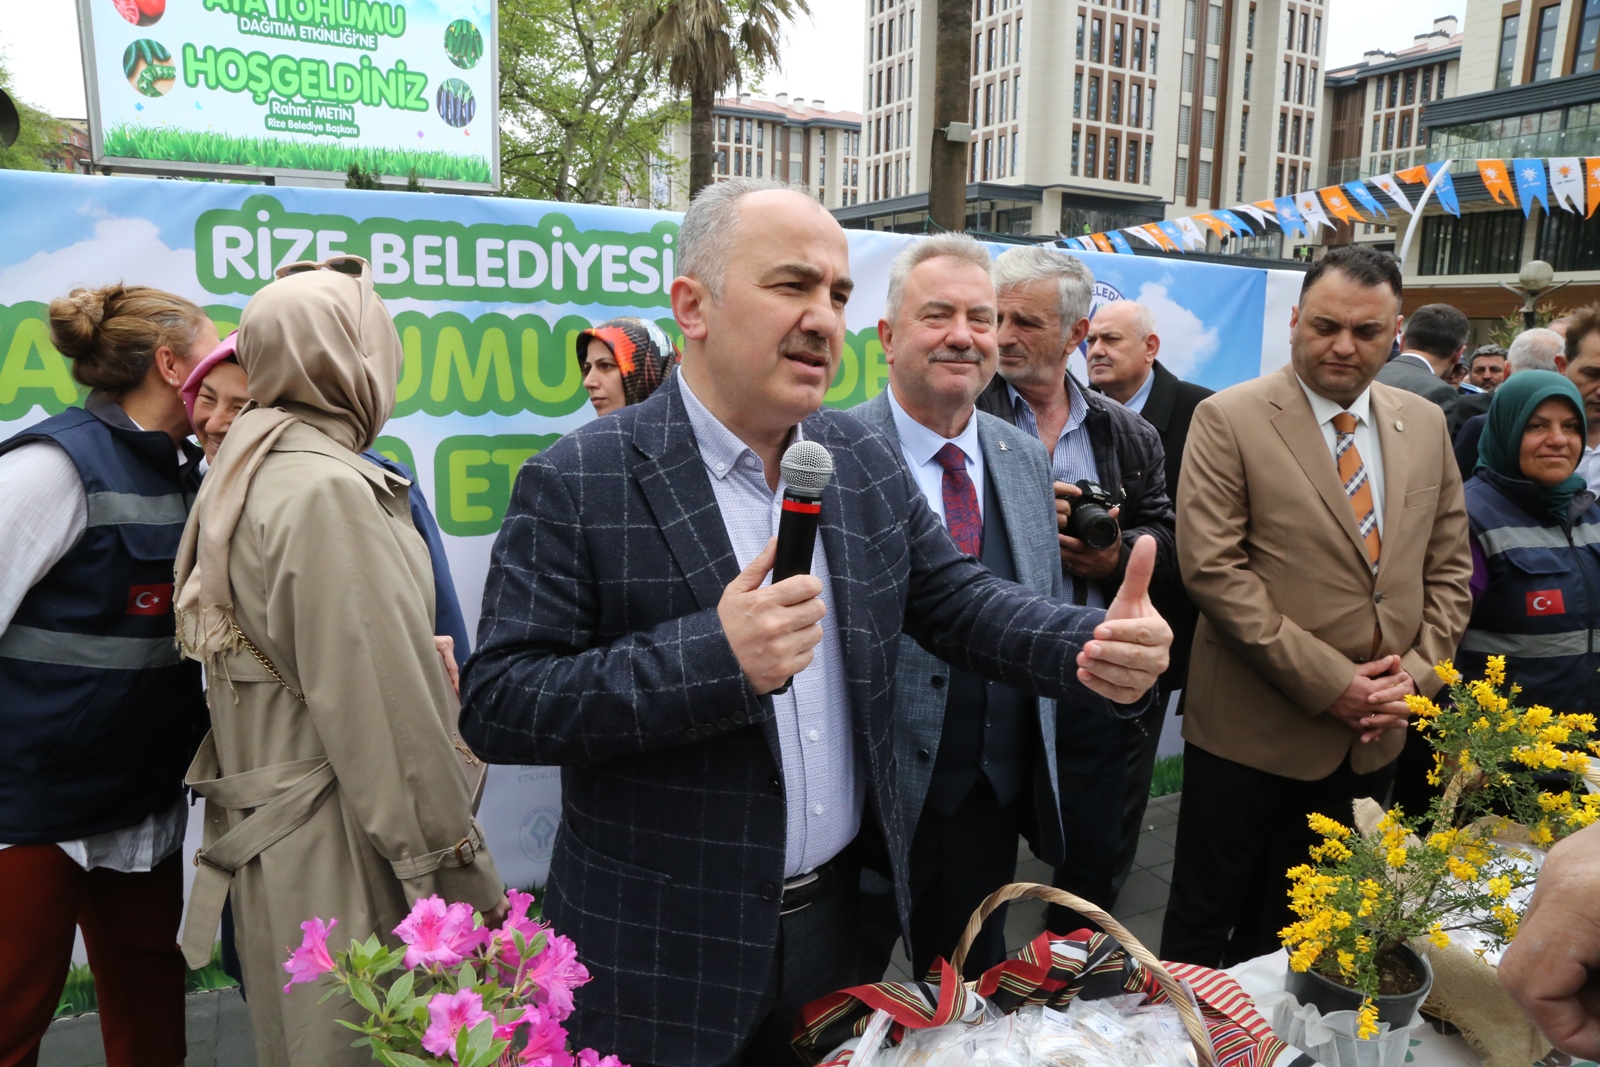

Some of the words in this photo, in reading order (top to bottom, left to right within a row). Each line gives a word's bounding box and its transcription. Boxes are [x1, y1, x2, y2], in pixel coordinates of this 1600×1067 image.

[240, 15, 297, 38] DAĞITIM
[185, 46, 428, 109] HOŞGELDİNİZ
[272, 101, 312, 118] Rahmi
[315, 103, 353, 121] METİN
[267, 117, 287, 130] Rize
[287, 119, 324, 133] Belediye
[325, 123, 358, 136] Başkanı
[371, 225, 674, 295] BELEDİYESİ
